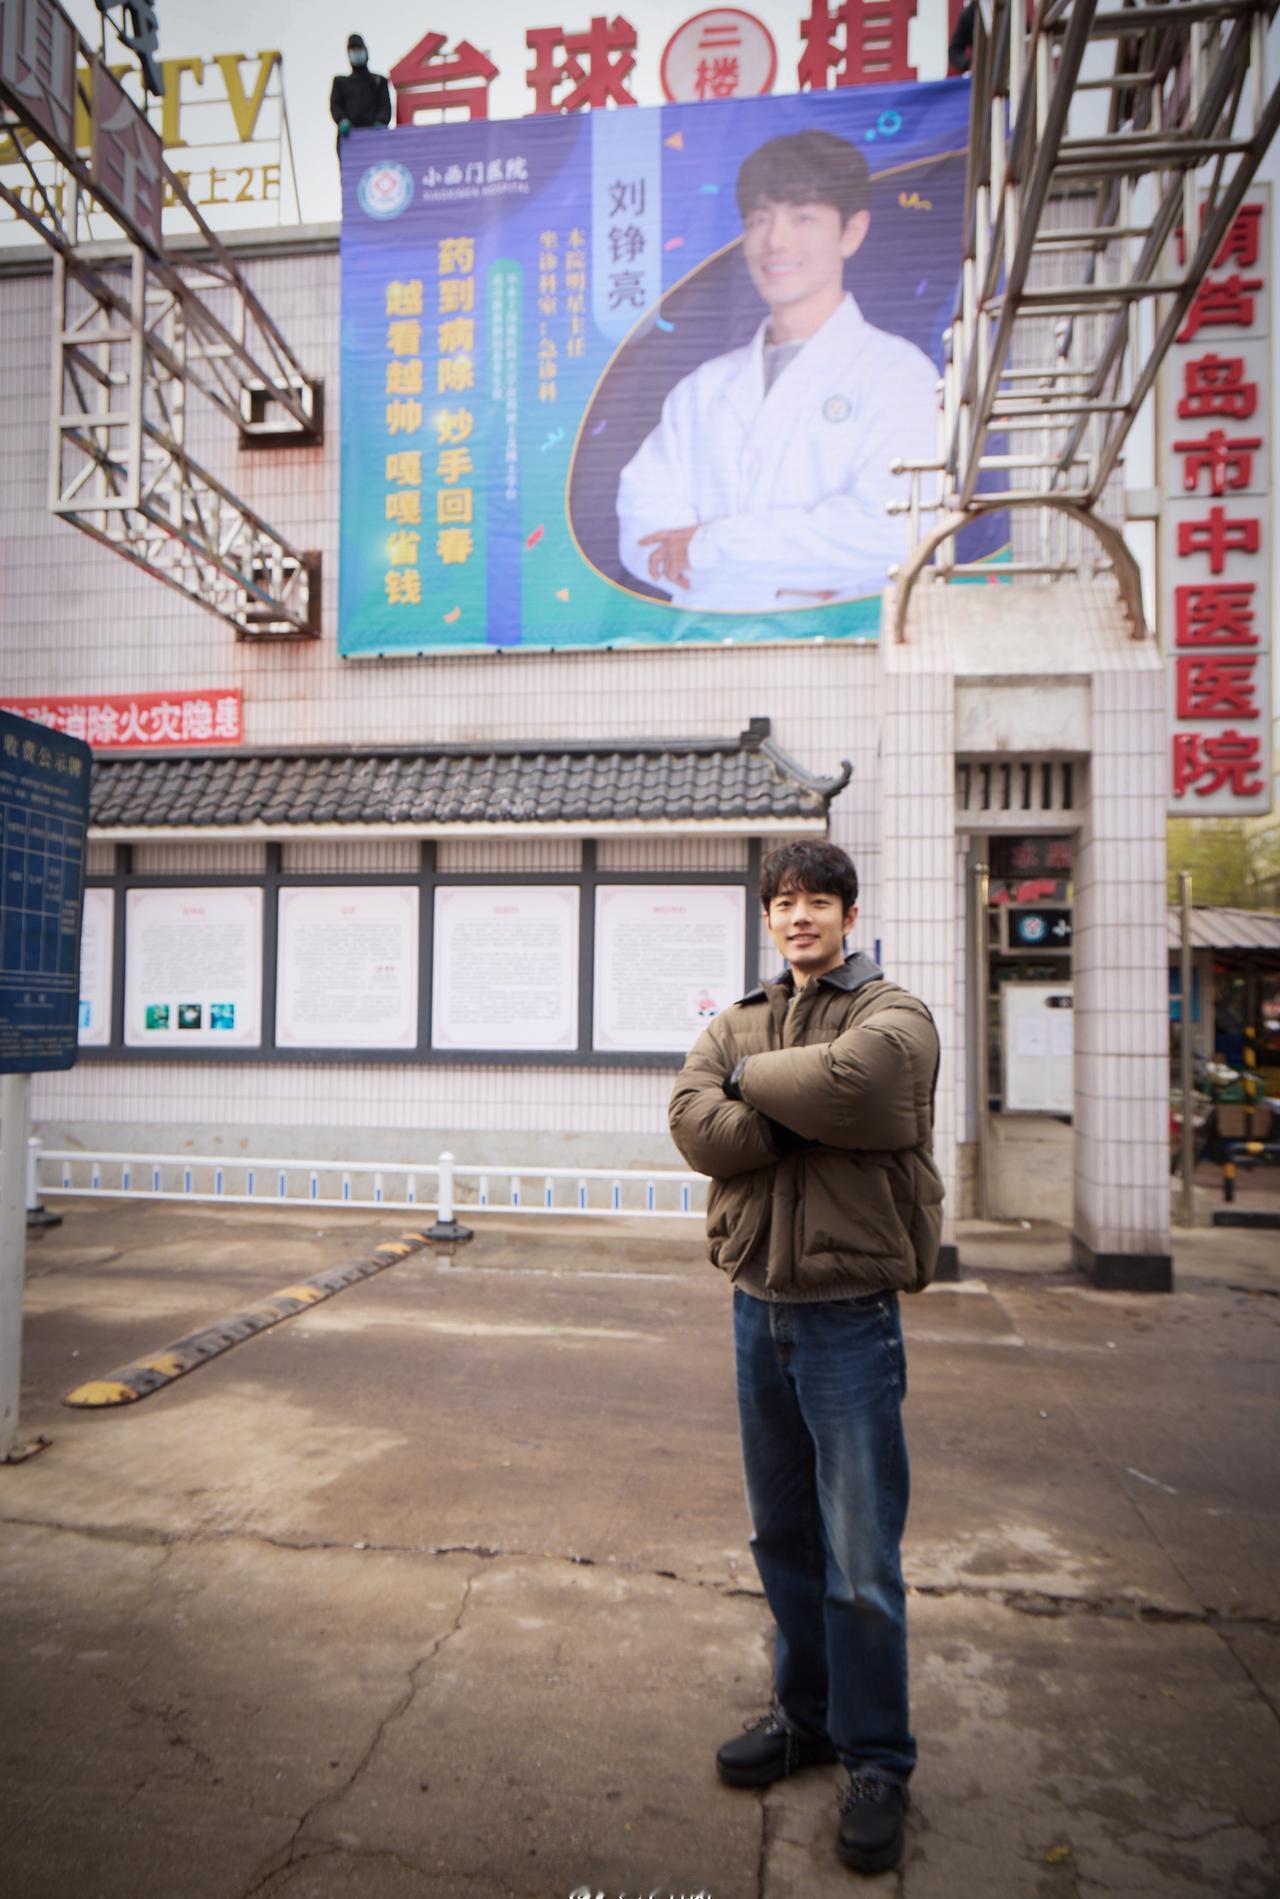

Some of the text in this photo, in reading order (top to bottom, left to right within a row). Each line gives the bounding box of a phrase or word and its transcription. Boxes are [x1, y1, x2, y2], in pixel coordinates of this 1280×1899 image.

[389, 15, 637, 127] 台球
[694, 24, 744, 99] 二楼
[607, 177, 647, 310] 刘铮亮
[384, 279, 423, 606] 越看越帅 嘎嘎省钱
[436, 236, 475, 565] 药到病除 妙手回春
[2, 696, 240, 744] 改消除火灾隐患
